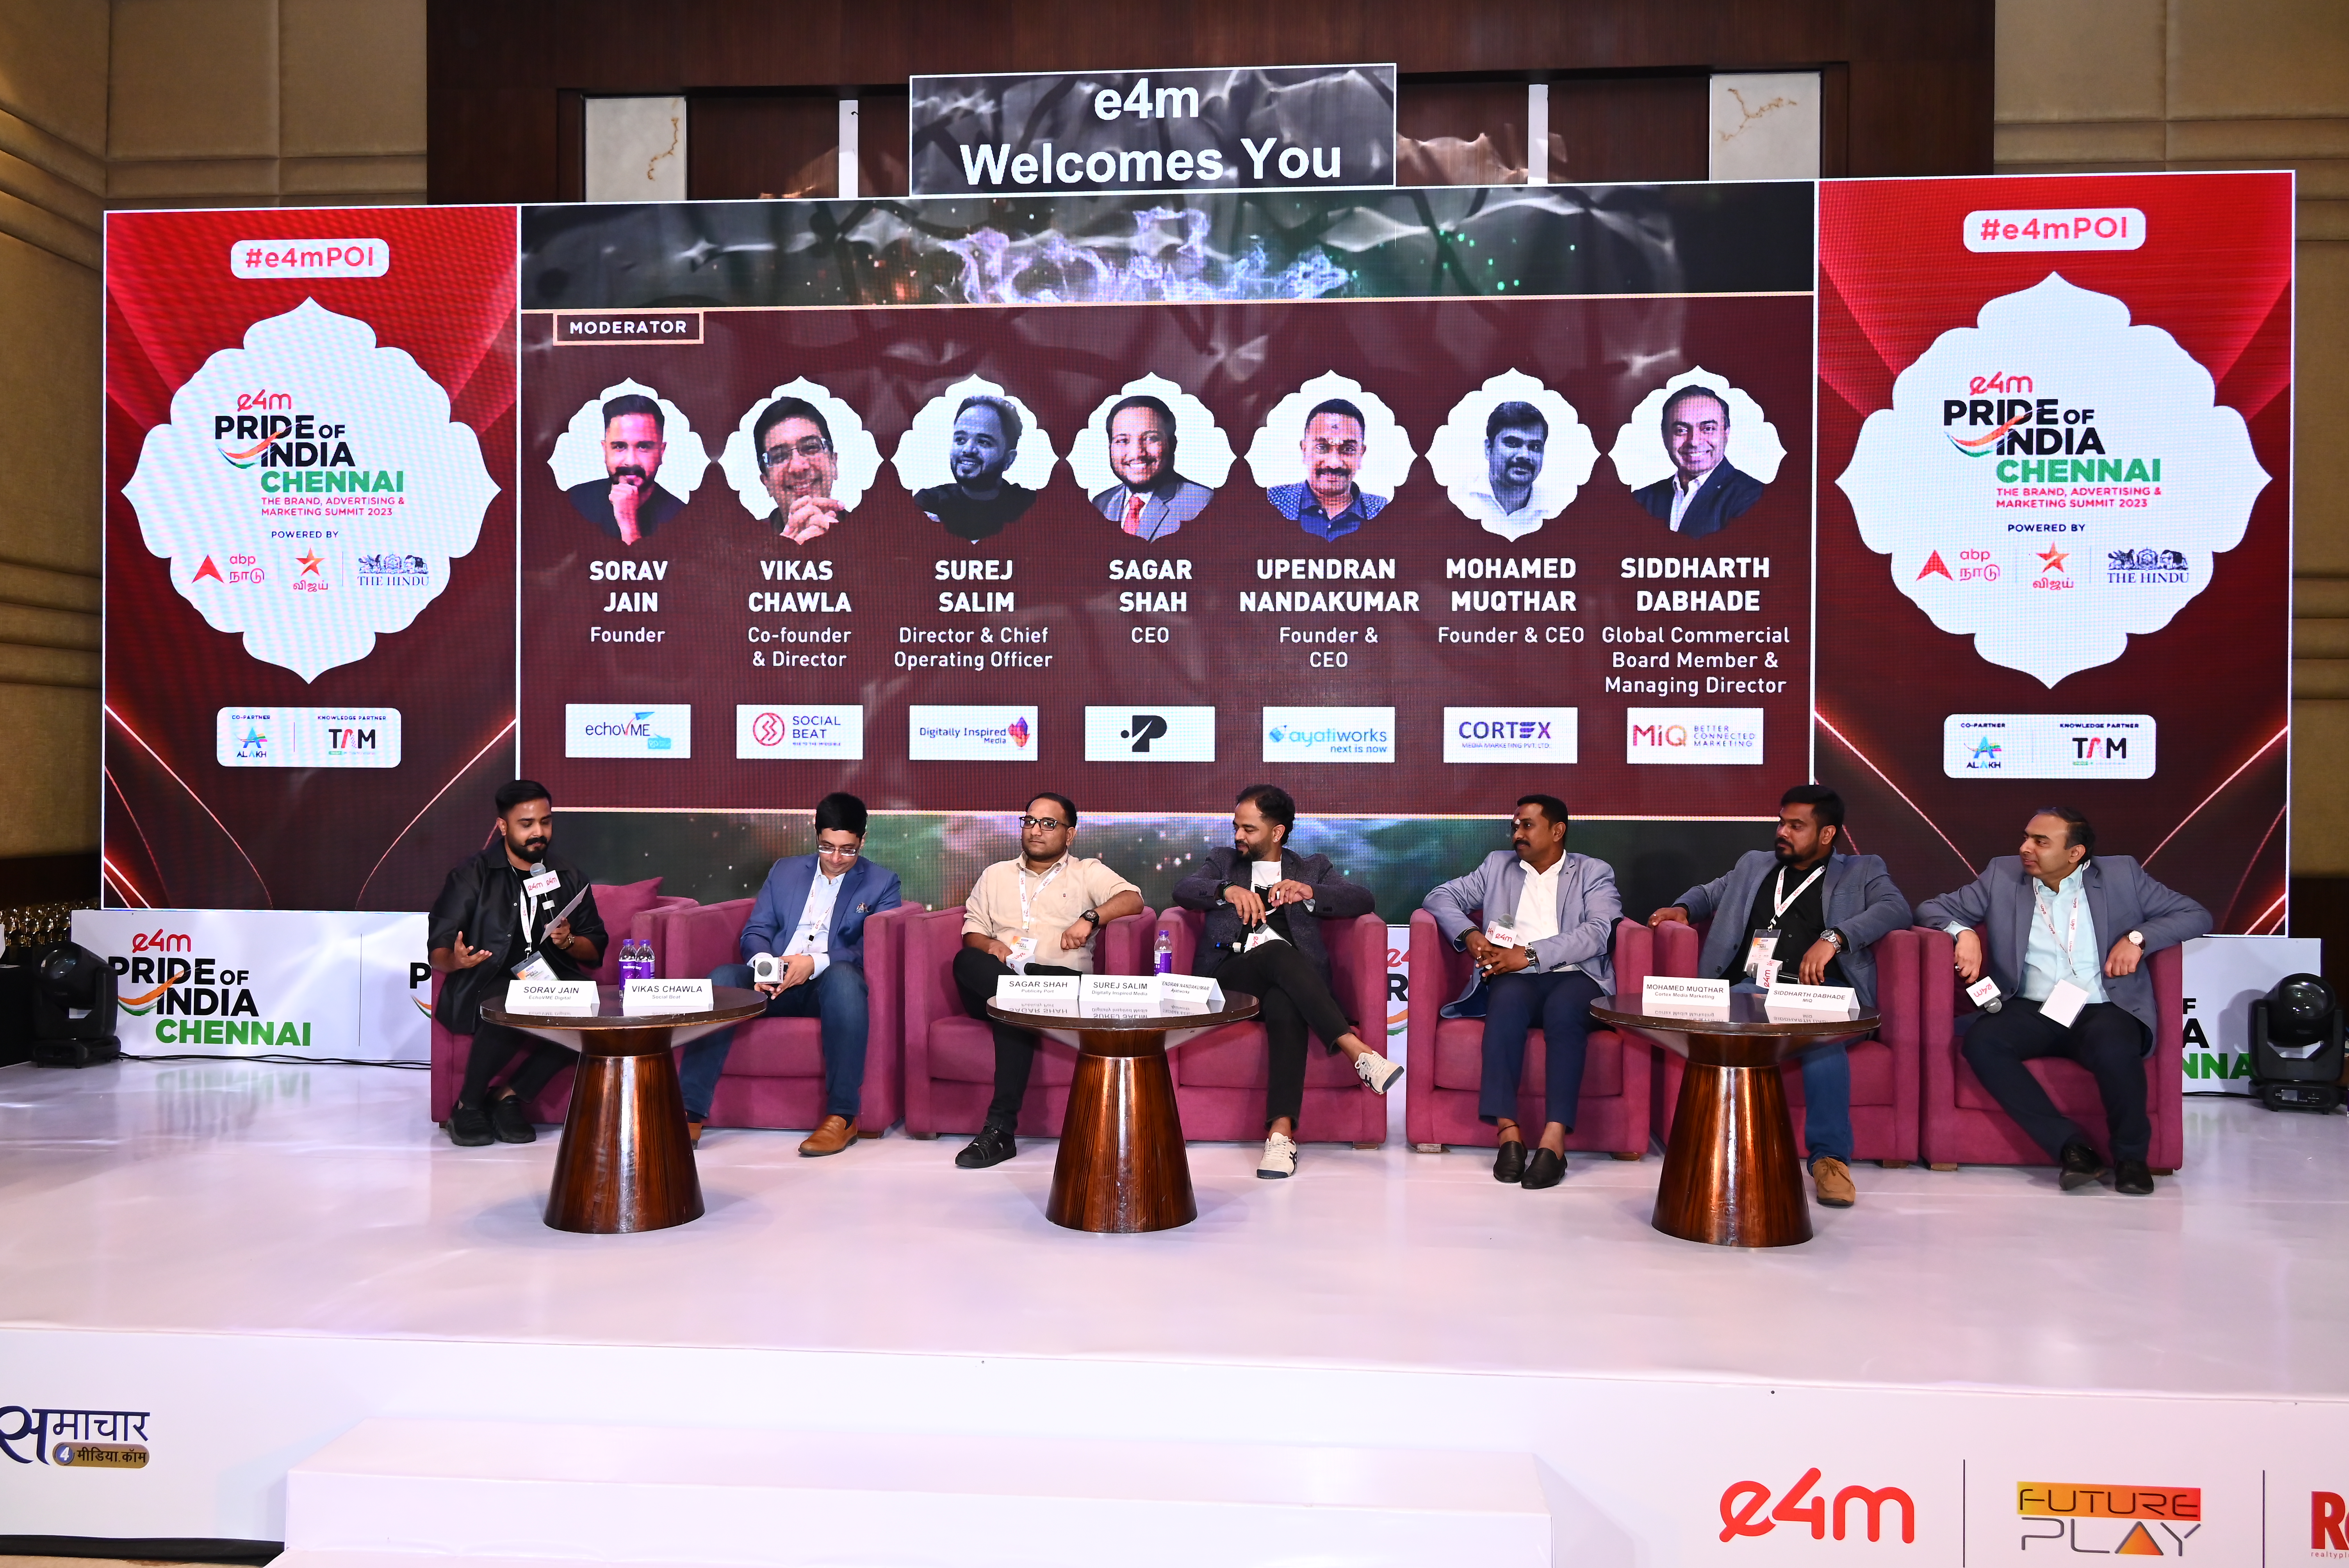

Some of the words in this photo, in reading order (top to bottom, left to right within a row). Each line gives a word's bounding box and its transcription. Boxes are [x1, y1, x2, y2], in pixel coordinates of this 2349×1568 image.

[1094, 78, 1199, 120] e4m
[960, 143, 1223, 185] Welcomes
[1240, 137, 1340, 179] You
[1980, 216, 2128, 241] #e4mPOI
[246, 246, 373, 267] #e4mPOI
[570, 320, 687, 334] MODERATOR
[1969, 371, 2032, 396] e4m
[237, 389, 291, 411] e4m
[1943, 399, 2058, 426] PRIDE
[2063, 409, 2094, 425] OF
[215, 415, 314, 440] PRIDE
[319, 424, 345, 438] OF
[1996, 427, 2105, 455] INDIA
[261, 442, 355, 467] INDIA
[1996, 458, 2160, 483] CHENNAI
[260, 470, 403, 493] CHENNAI
[284, 497, 323, 506] BRAND,
[1997, 488, 2019, 496] THE
[2023, 488, 2067, 497] BRAND,
[2071, 487, 2151, 496] ADVERTISING
[2154, 487, 2161, 495] &
[1997, 500, 2066, 508] MARKETING
[2069, 499, 2115, 508] SUMMIT
[2119, 499, 2147, 507] 2023
[230, 553, 256, 566] abp
[1960, 549, 1990, 561] abp
[229, 568, 264, 584] நாடு
[590, 561, 668, 581] SORAV
[760, 560, 833, 581] VIKAS
[935, 560, 1013, 580] SUREJ
[1109, 559, 1192, 580] SAGAR
[1257, 559, 1395, 579] UPENDRAN
[1446, 558, 1576, 579] MOHAMED
[1621, 557, 1769, 579] SIDDHARTH
[1960, 563, 2000, 581] நாடு
[2107, 573, 2136, 583] THE
[2140, 573, 2189, 583] HINDU
[293, 579, 328, 592] விஜய்
[358, 576, 383, 586] THE
[387, 576, 429, 586] HINDU
[2033, 577, 2074, 590] விஜய்
[604, 592, 658, 612] JAIN
[749, 592, 852, 612] CHAWLA
[939, 592, 1014, 612] SALIM
[1119, 592, 1187, 612] SHAH
[1240, 591, 1419, 612] NANDAKUMAR
[1452, 590, 1577, 612] MUQTHAR
[1637, 590, 1760, 611] DABHADE
[591, 627, 665, 643] Founder
[749, 627, 852, 643] Co-founder
[900, 627, 974, 643] Director
[980, 627, 993, 643] &
[1000, 627, 1048, 643] Chief
[1132, 627, 1169, 643] CEO
[1280, 627, 1358, 643] Founder
[1365, 627, 1378, 643] &
[1438, 627, 1517, 643] Founder
[1524, 627, 1538, 643] &
[1546, 627, 1584, 643] CEO
[1602, 627, 1664, 643] Global
[1671, 627, 1790, 643] Commercial
[752, 652, 765, 666] &
[773, 650, 847, 666] Director
[895, 651, 984, 671] Operating
[991, 651, 1053, 667] Officer
[1310, 652, 1348, 668] CEO
[1613, 652, 1669, 668] Board
[1677, 652, 1757, 668] Member
[1764, 653, 1778, 668] &
[1606, 677, 1698, 697] Managing
[1706, 677, 1786, 693] Director
[586, 722, 650, 736] echoVME
[793, 716, 841, 725] SOCIAL
[1459, 722, 1551, 739] CORTEX
[329, 729, 375, 748] TAM
[793, 729, 827, 738] BEAT
[920, 727, 960, 738] Digitally
[964, 727, 1006, 738] Inspired
[1290, 728, 1387, 747] ayatiworks
[1633, 725, 1687, 747] MiQ
[1331, 745, 1353, 753] next
[1355, 744, 1363, 753] is
[2073, 738, 2126, 759] TAM
[528, 882, 543, 891] e4m
[132, 929, 191, 953] e4m
[1495, 934, 1512, 943] e4m
[108, 957, 215, 985] PRIDE
[220, 970, 249, 985] OF
[1973, 983, 1992, 998] e4m
[157, 987, 259, 1016] INDIA
[156, 1018, 310, 1046] CHENNAI
[0, 1405, 150, 1465] समाचार
[60, 1447, 70, 1461] 4
[1719, 1468, 1914, 1543] e4m
[2020, 1489, 2198, 1517] FUTURE
[2021, 1517, 2201, 1556] PLAY
